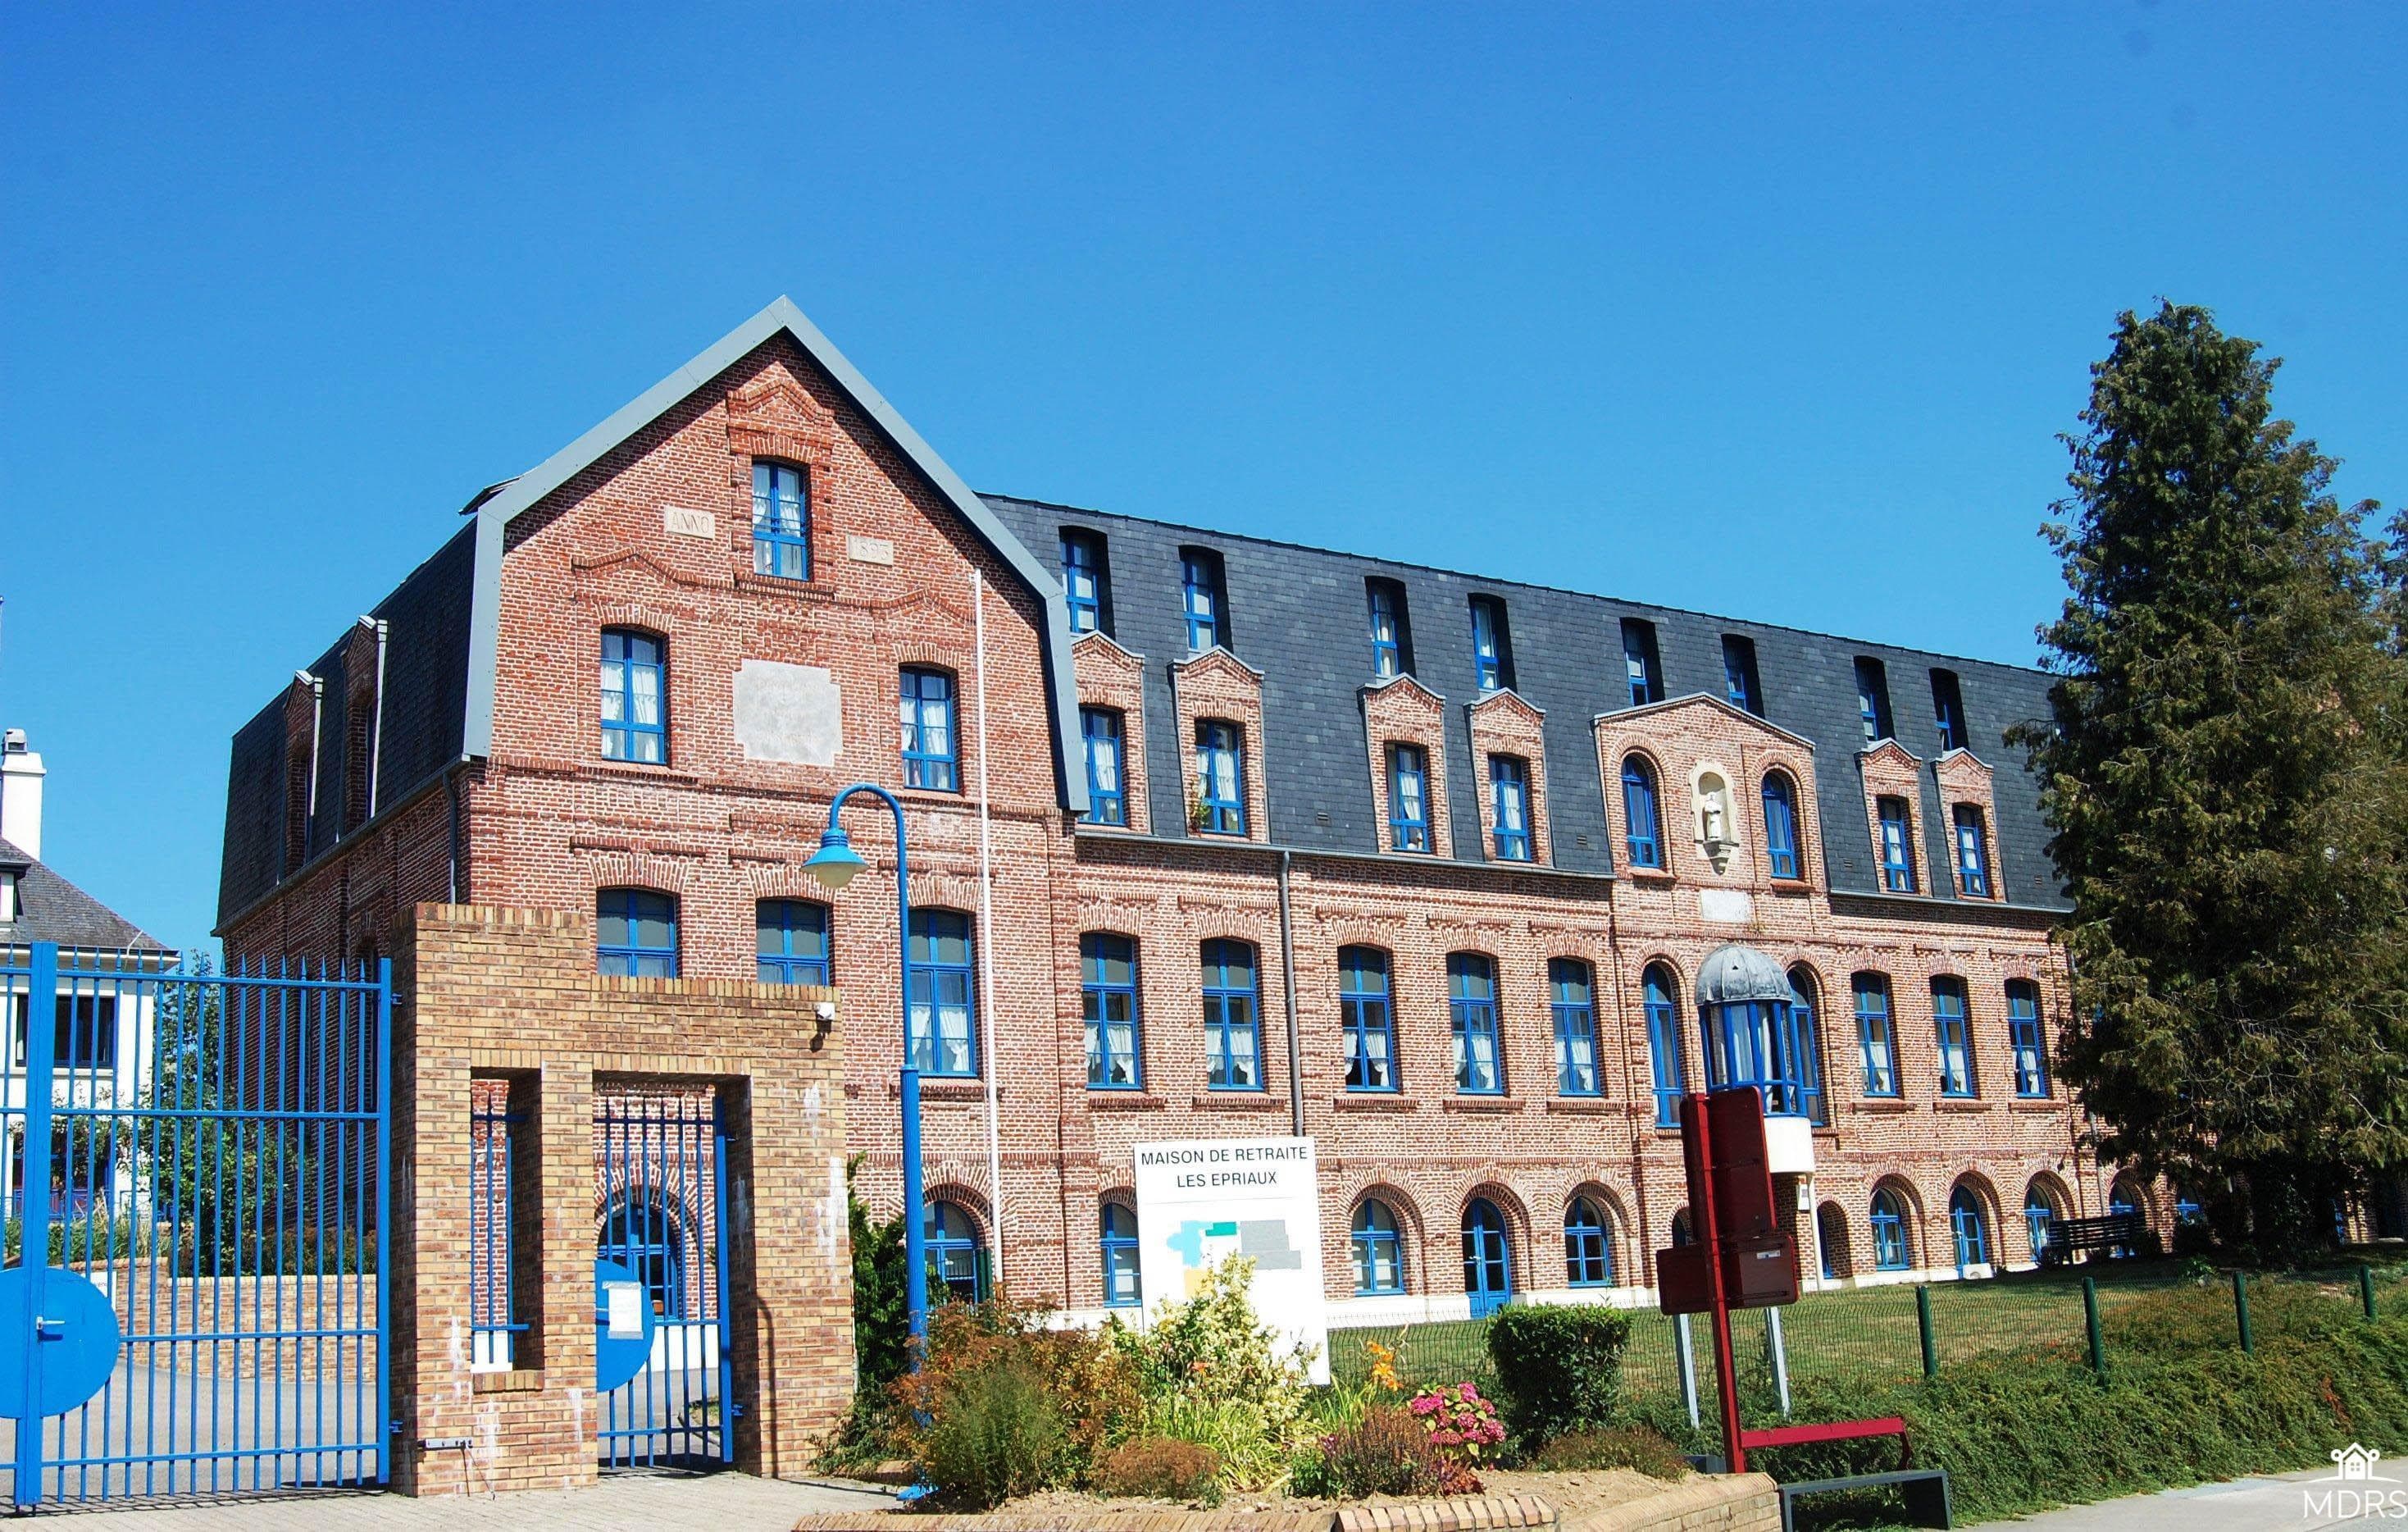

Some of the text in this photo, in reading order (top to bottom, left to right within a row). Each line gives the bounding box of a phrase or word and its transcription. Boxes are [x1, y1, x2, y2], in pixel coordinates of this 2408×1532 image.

[670, 512, 710, 533] ANNO
[1140, 1147, 1308, 1165] MAISON DE RETRAITE
[1177, 1171, 1277, 1188] LES EPRIAUX
